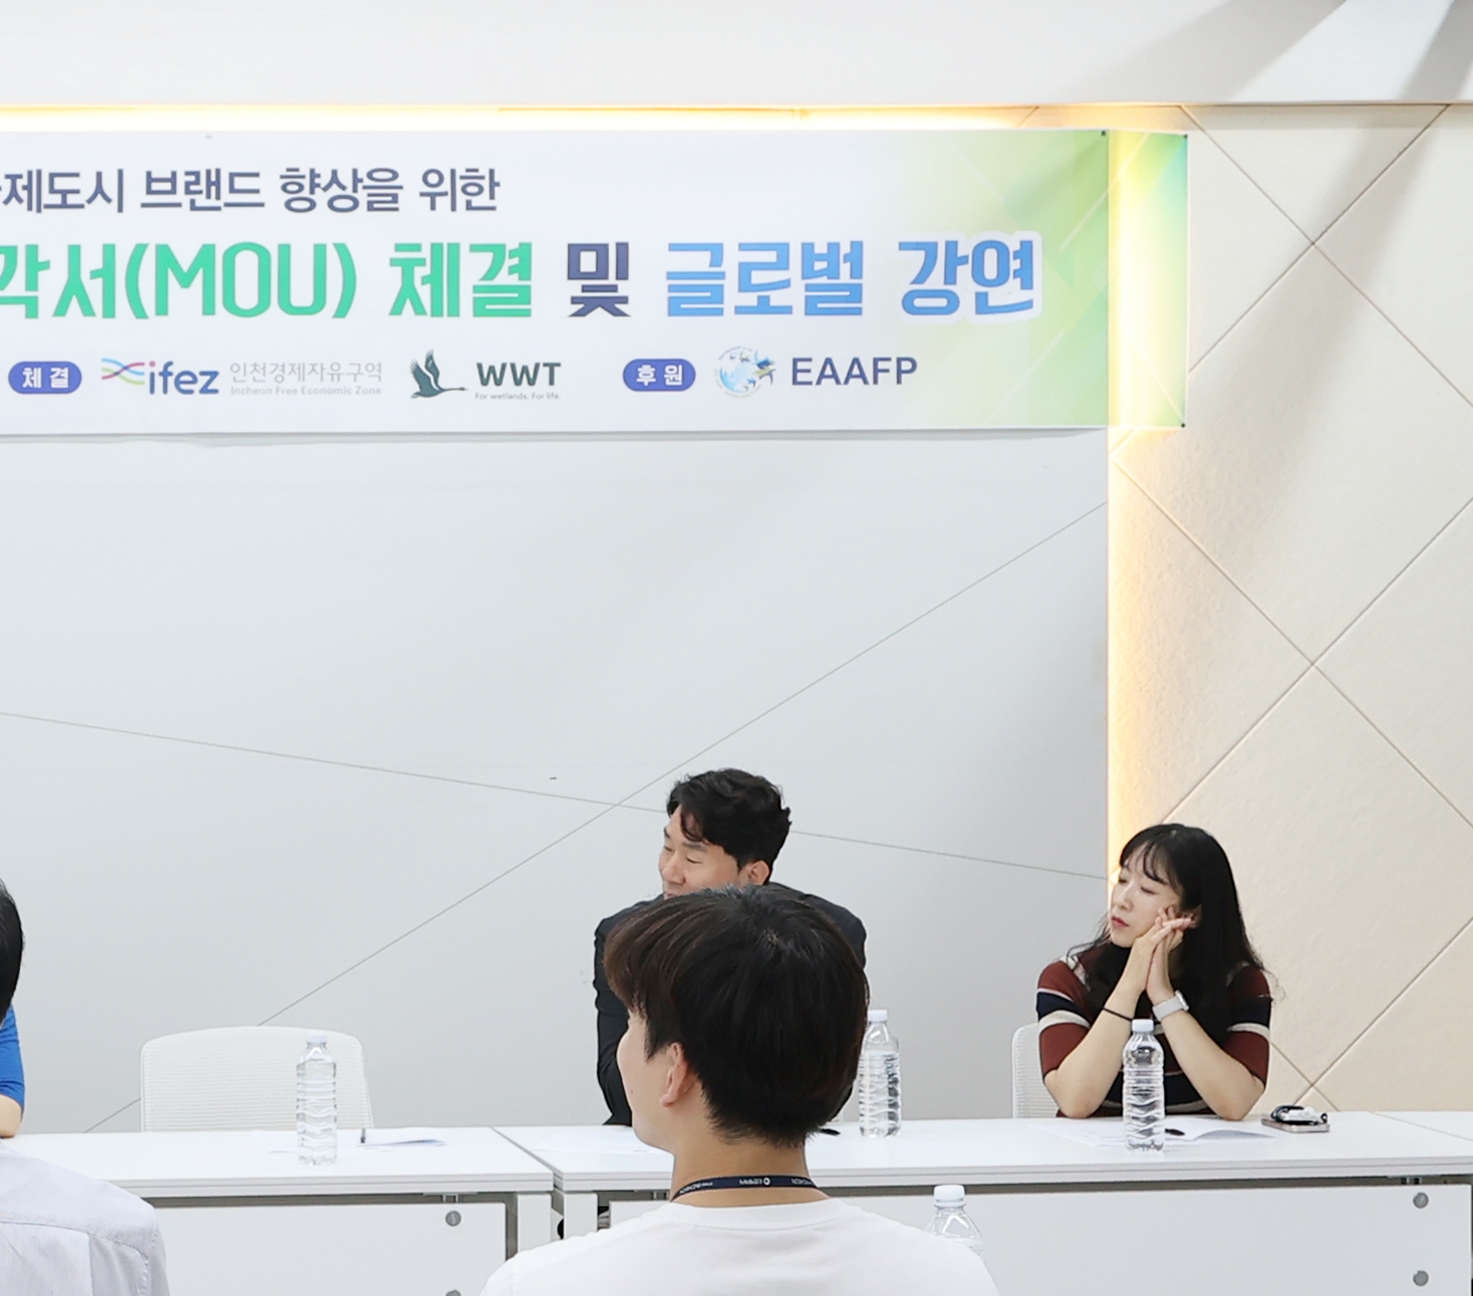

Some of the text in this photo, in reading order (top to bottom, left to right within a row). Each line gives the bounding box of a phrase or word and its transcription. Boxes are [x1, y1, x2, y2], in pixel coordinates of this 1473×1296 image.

[140, 168, 265, 211] 브랜드
[280, 168, 403, 213] 향상을
[419, 168, 500, 212] 위한
[389, 242, 532, 318] 체결
[567, 242, 630, 317] 및
[666, 241, 863, 317] 글로벌
[899, 241, 1036, 317] 강연
[149, 361, 219, 395] ifez
[230, 362, 381, 383] 인천경제자유구역
[477, 362, 561, 386] WWT
[792, 357, 917, 385] EAAFP
[231, 385, 380, 395] Incheon Free Economic Zone
[475, 392, 487, 400] For
[490, 392, 529, 400] wetlands.
[532, 392, 544, 400] For
